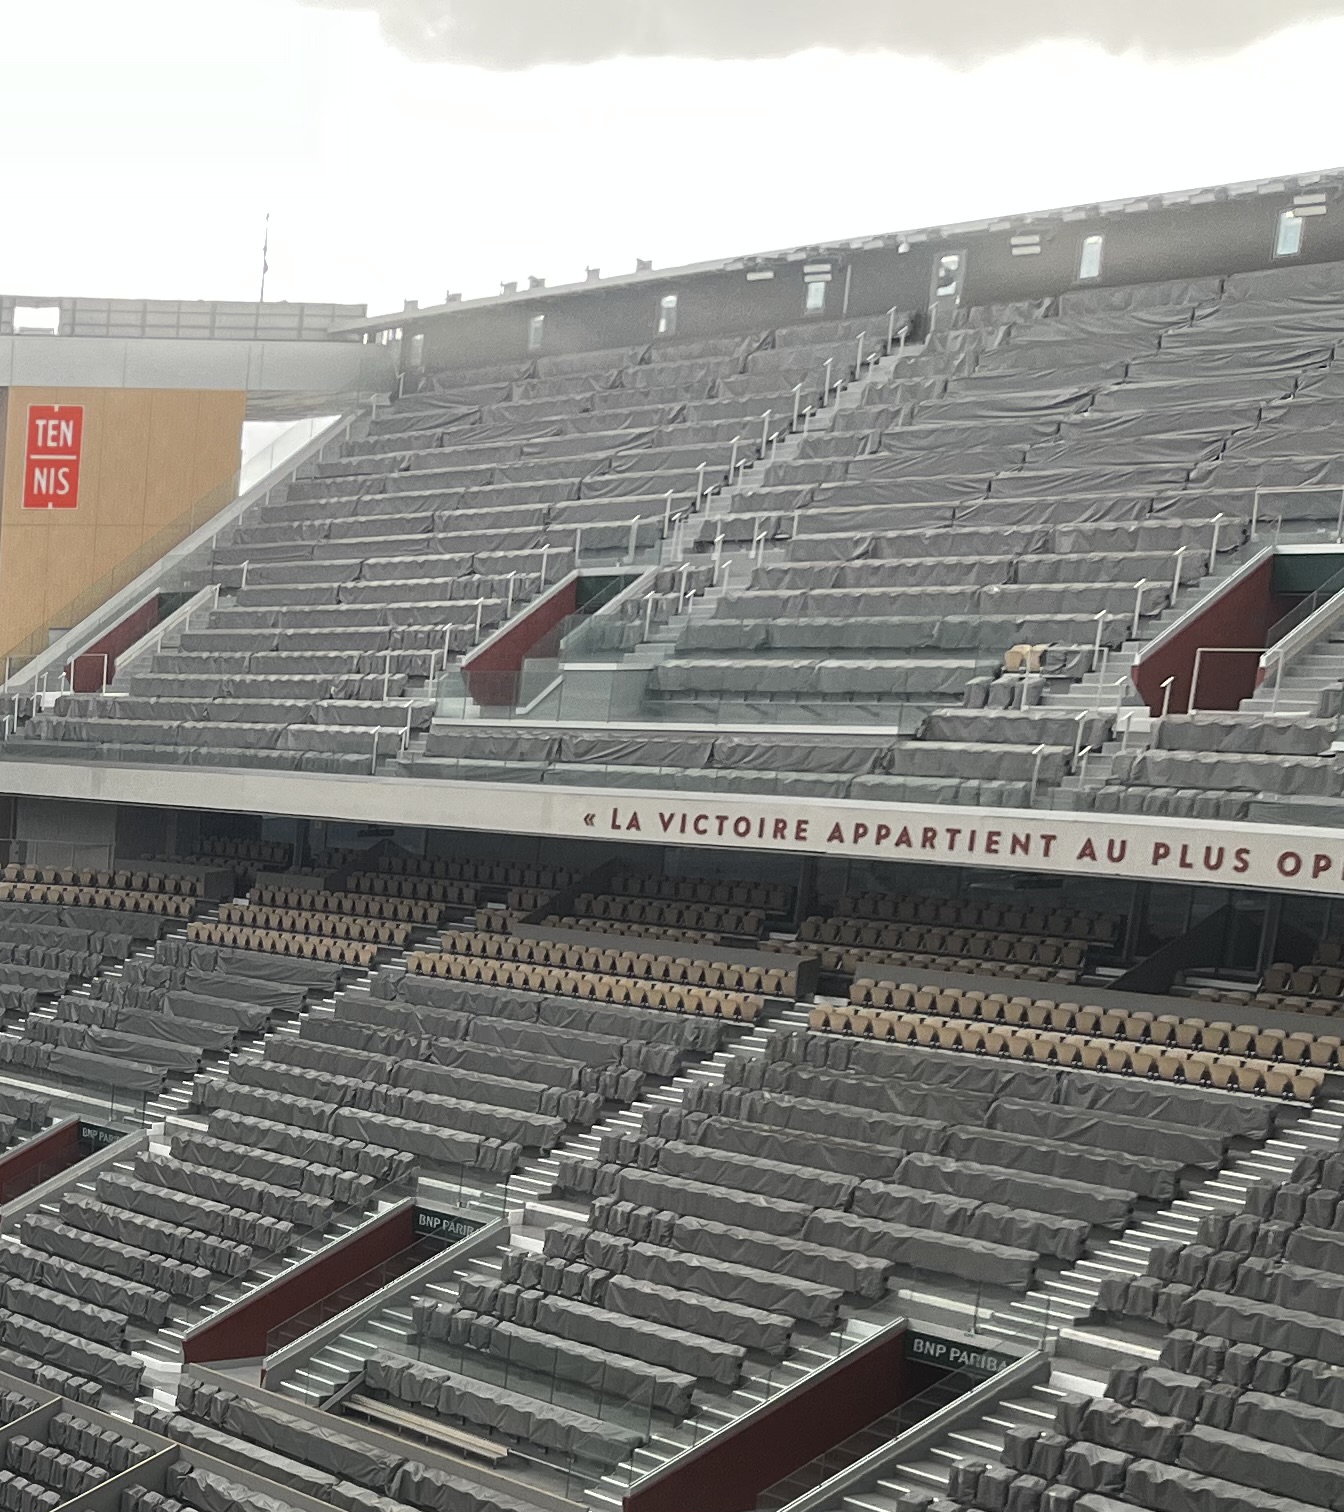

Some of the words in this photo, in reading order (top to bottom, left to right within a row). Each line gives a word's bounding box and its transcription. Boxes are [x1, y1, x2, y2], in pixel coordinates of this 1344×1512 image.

[35, 419, 74, 447] TEN
[33, 467, 70, 495] NIS
[611, 807, 642, 832] LA
[658, 812, 810, 842] VICTOIRE
[827, 821, 1057, 858] APPARTIENT
[1076, 837, 1127, 863] AU
[1151, 842, 1251, 873] PLUS
[1277, 851, 1344, 881] OP
[418, 1213, 441, 1229] BNP
[442, 1219, 474, 1236] PARIB
[913, 1338, 946, 1358] BNP
[949, 1347, 1007, 1373] PARIBA
